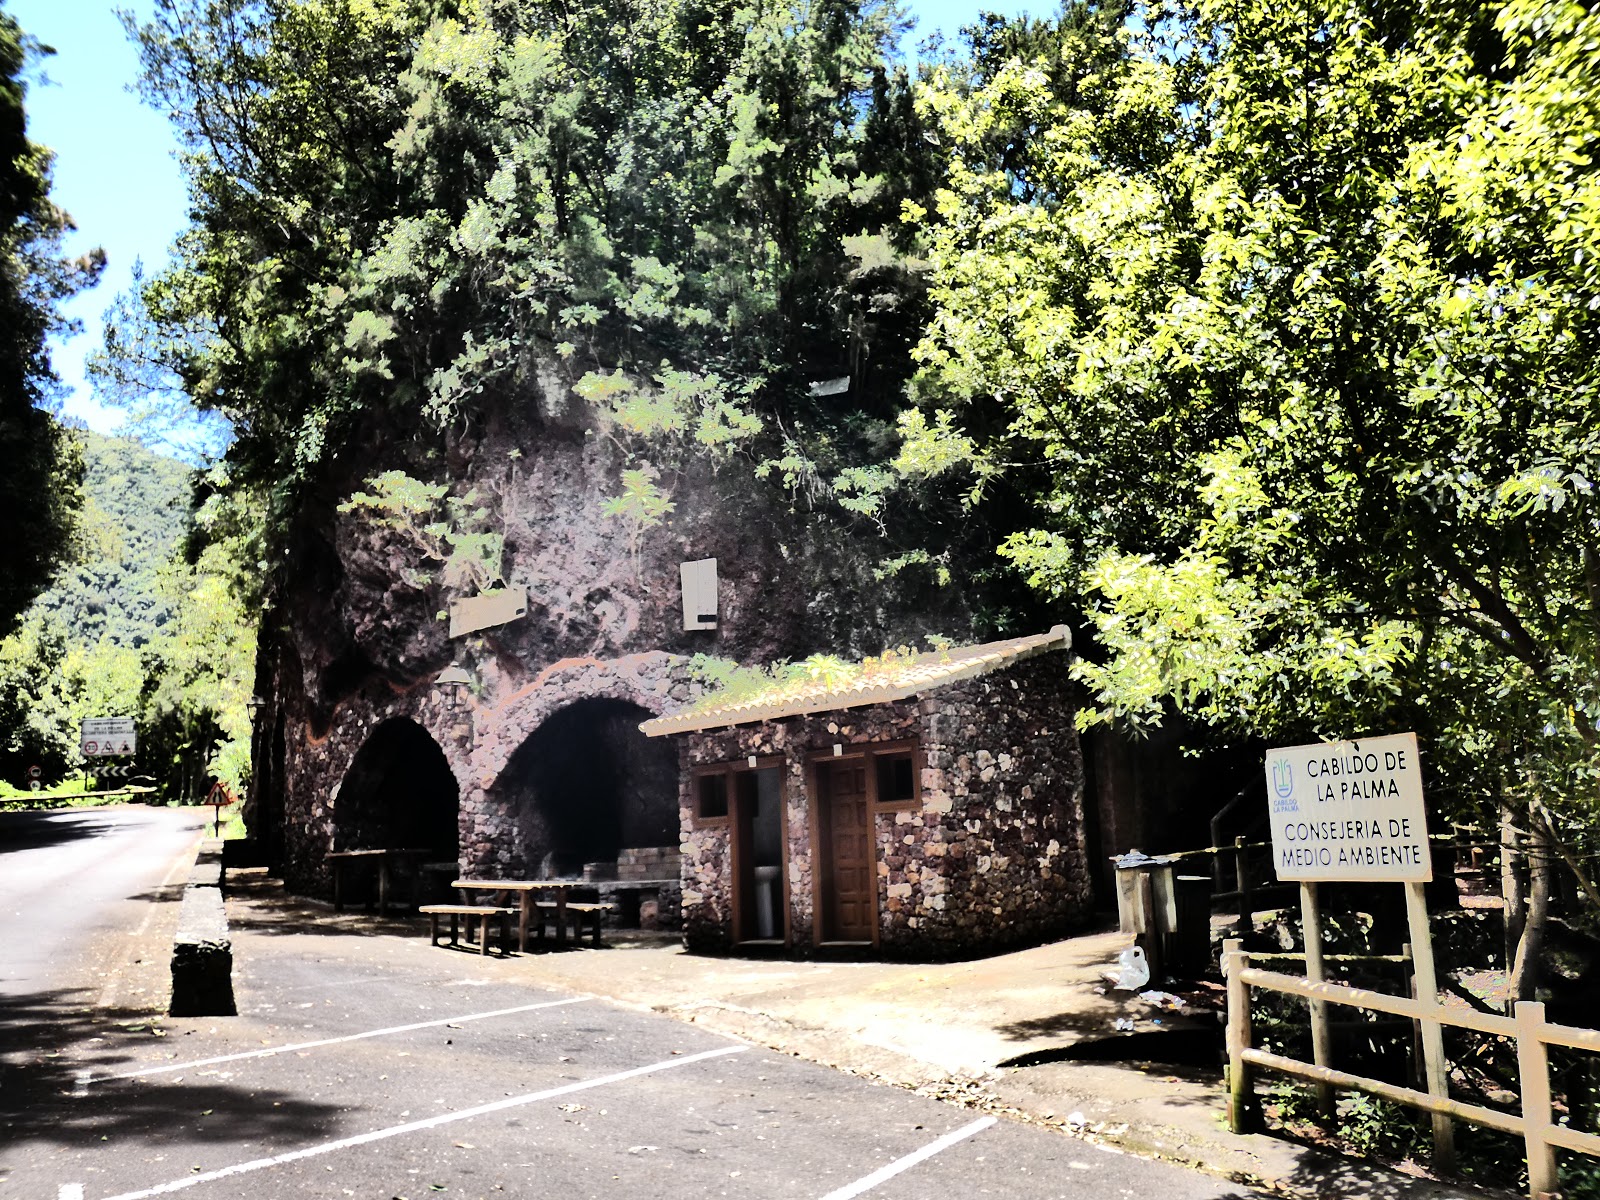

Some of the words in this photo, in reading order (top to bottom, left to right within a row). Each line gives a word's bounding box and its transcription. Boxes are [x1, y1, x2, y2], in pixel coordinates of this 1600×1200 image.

[1307, 753, 1378, 778] CABILDO
[1384, 750, 1407, 771] DE
[1317, 783, 1336, 802] LA
[1341, 779, 1400, 801] PALMA
[1281, 805, 1299, 813] PALMA
[1284, 820, 1382, 841] CONSEJERIA
[1388, 818, 1411, 838] DE
[1281, 847, 1332, 868] MEDIO
[1338, 845, 1421, 867] AMBIENTE
